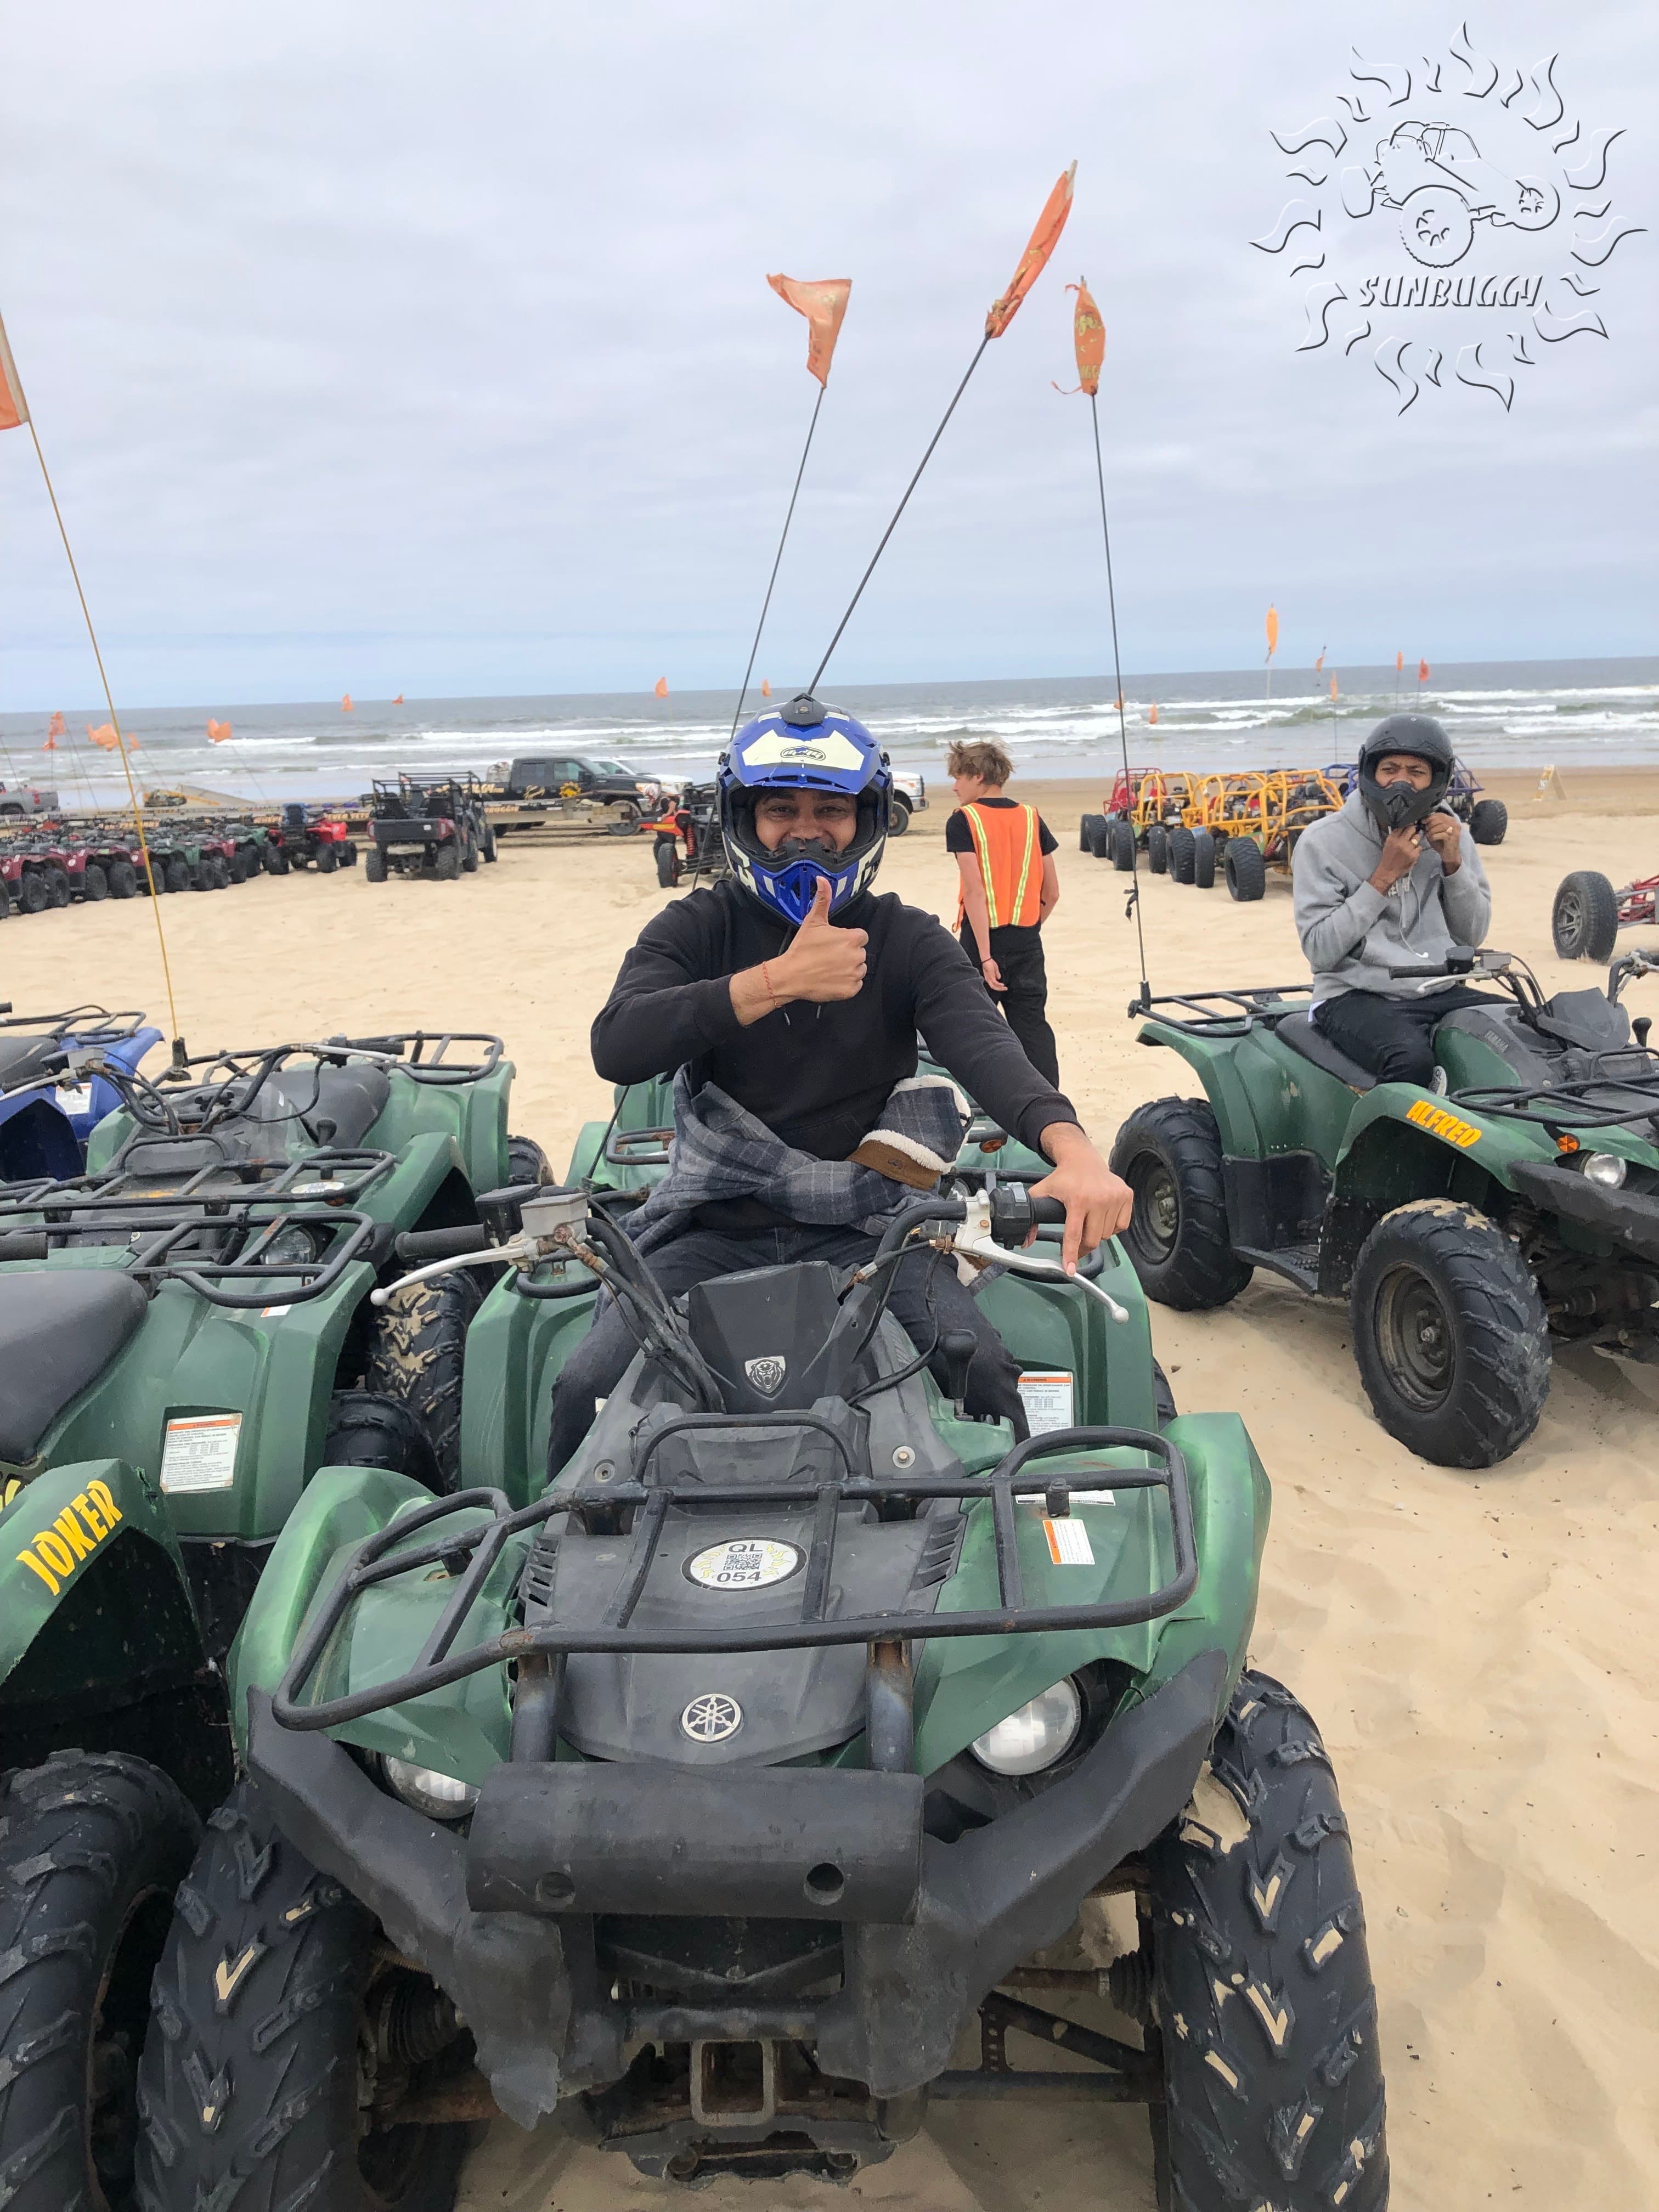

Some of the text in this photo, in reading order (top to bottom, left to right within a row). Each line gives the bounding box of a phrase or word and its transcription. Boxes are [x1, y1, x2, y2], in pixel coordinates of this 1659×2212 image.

[1406, 1099, 1482, 1148] ALFRED
[15, 1480, 123, 1596] JOKER
[728, 1543, 763, 1553] QL
[716, 1571, 761, 1582] 054
